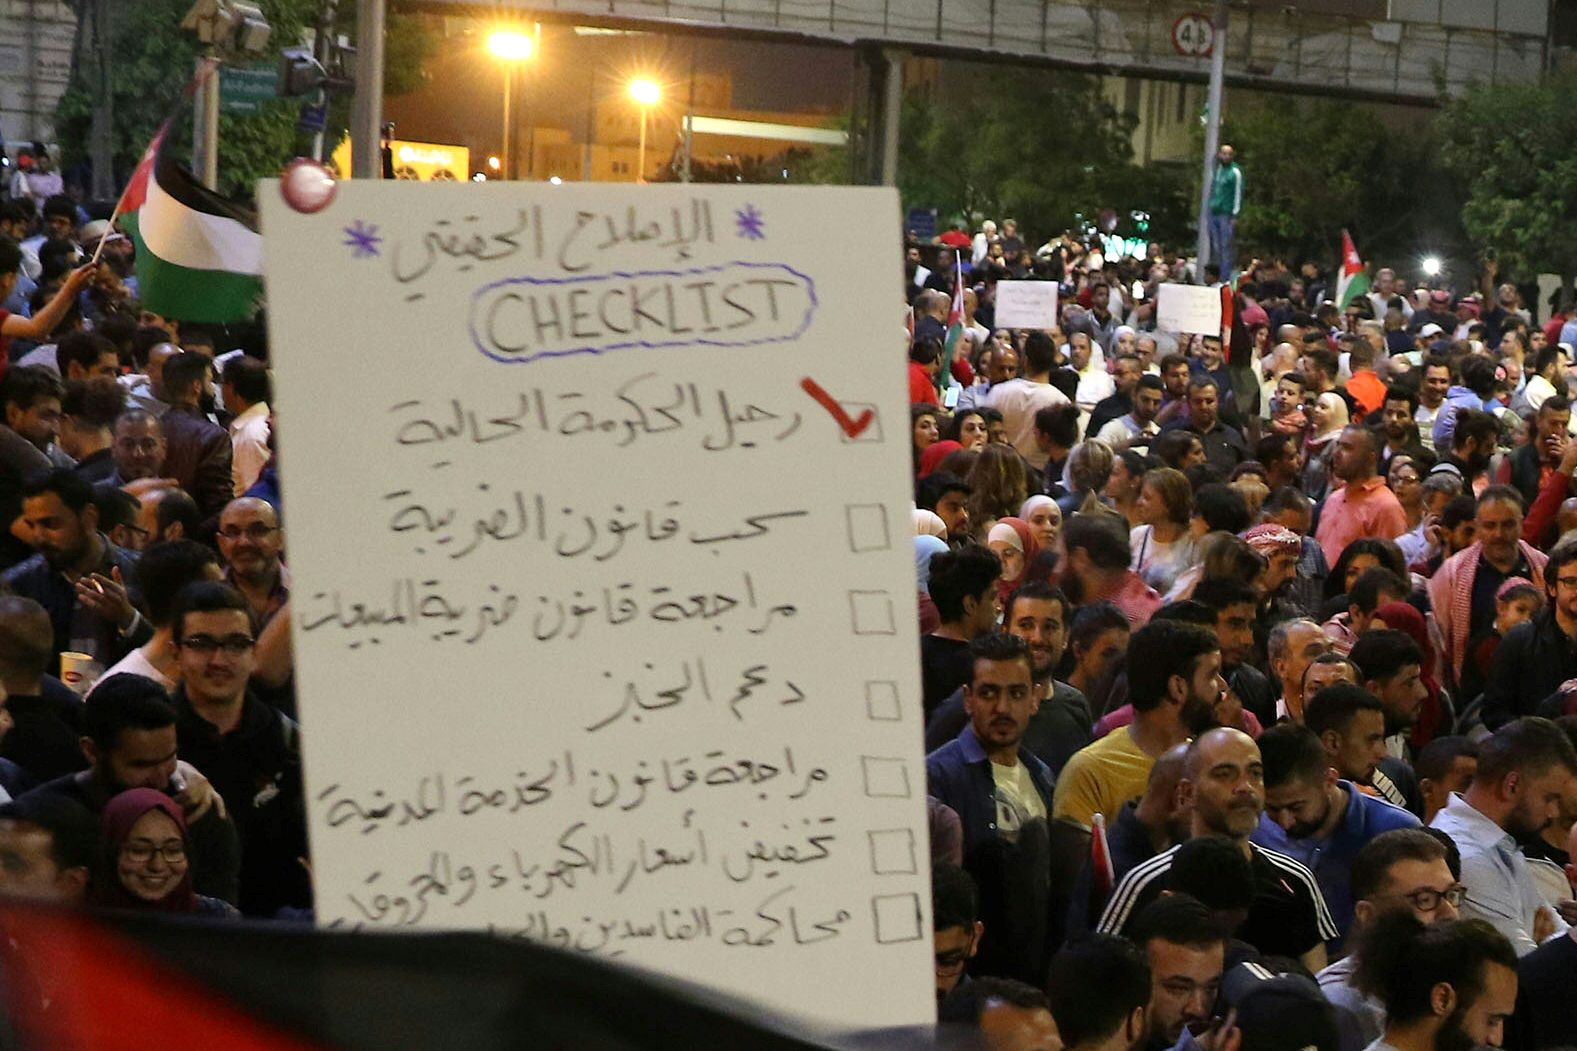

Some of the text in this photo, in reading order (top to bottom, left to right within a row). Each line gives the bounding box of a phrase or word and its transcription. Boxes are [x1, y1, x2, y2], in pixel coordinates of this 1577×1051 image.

[392, 199, 714, 304] الإصلاح الحقيقي
[485, 278, 799, 356] CHECKLIST
[390, 373, 804, 470] رحيل الحكومة الحالية
[382, 483, 810, 562] سحب قانون الضريبة
[301, 571, 798, 651] مراجعة قانون ضريبة المبيعات
[584, 658, 807, 734] دعم الخبز
[317, 746, 830, 836] مراجعة قانون الخدمة المدنية
[488, 821, 614, 900] الكهرباء
[615, 808, 709, 895] أسعار
[722, 815, 837, 884] تخفيض
[575, 905, 713, 958] الفاسدين
[720, 884, 853, 949] محاكمة
